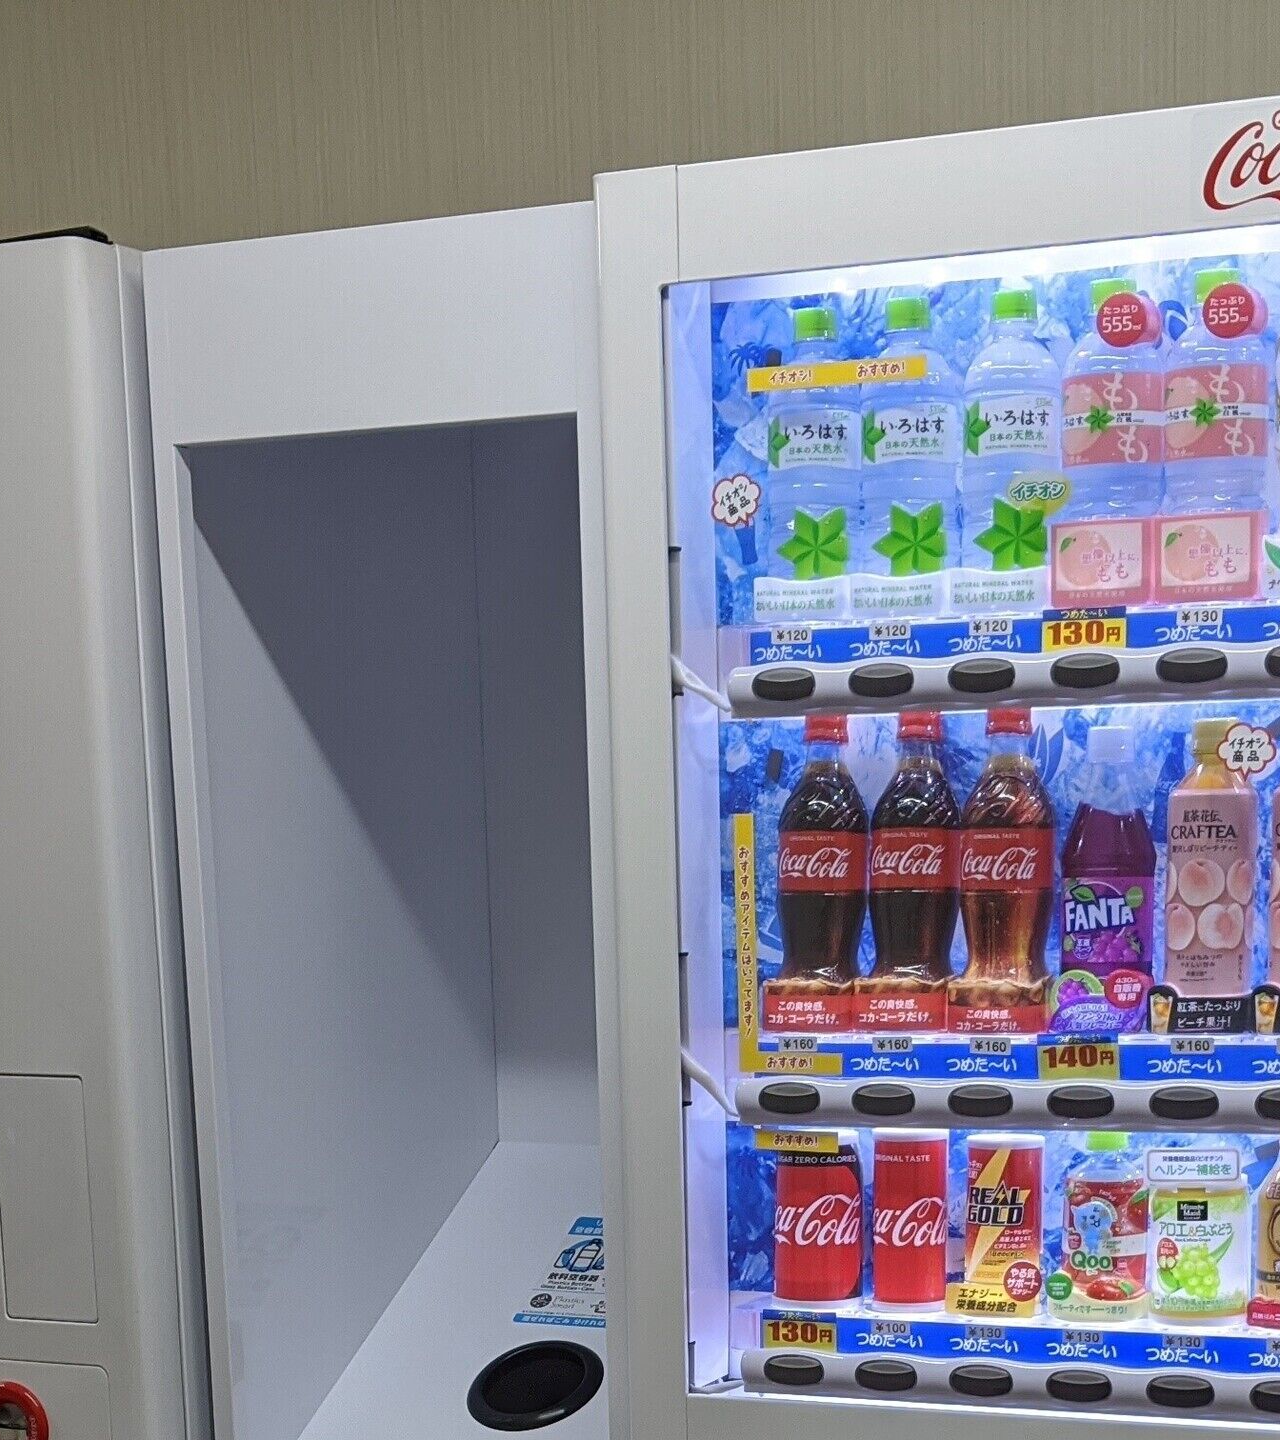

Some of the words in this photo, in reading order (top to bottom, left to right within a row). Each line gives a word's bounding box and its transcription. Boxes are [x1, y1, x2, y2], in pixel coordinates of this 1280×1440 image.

[1010, 481, 1066, 500] イチオシ
[1182, 610, 1218, 623] ¥130
[874, 625, 907, 637] ¥120
[972, 620, 1008, 633] ¥120
[1047, 620, 1121, 645] 130円
[776, 629, 808, 641] ¥120
[1171, 825, 1236, 839] CRAFTEA
[779, 847, 852, 879] Coca-Cola
[871, 843, 945, 876] Coca-Cola
[961, 847, 1041, 880] Coca-Cola
[1065, 898, 1134, 932] FANTA
[1177, 1000, 1240, 1012] 紅茶にたっぷり
[1043, 1045, 1114, 1069] 140円
[1155, 1164, 1231, 1175] ヘルシー補給を
[1071, 1251, 1113, 1270] Qoo
[767, 1322, 833, 1343] 130円
[876, 1323, 906, 1333] ¥100
[1065, 1332, 1099, 1342] ¥130
